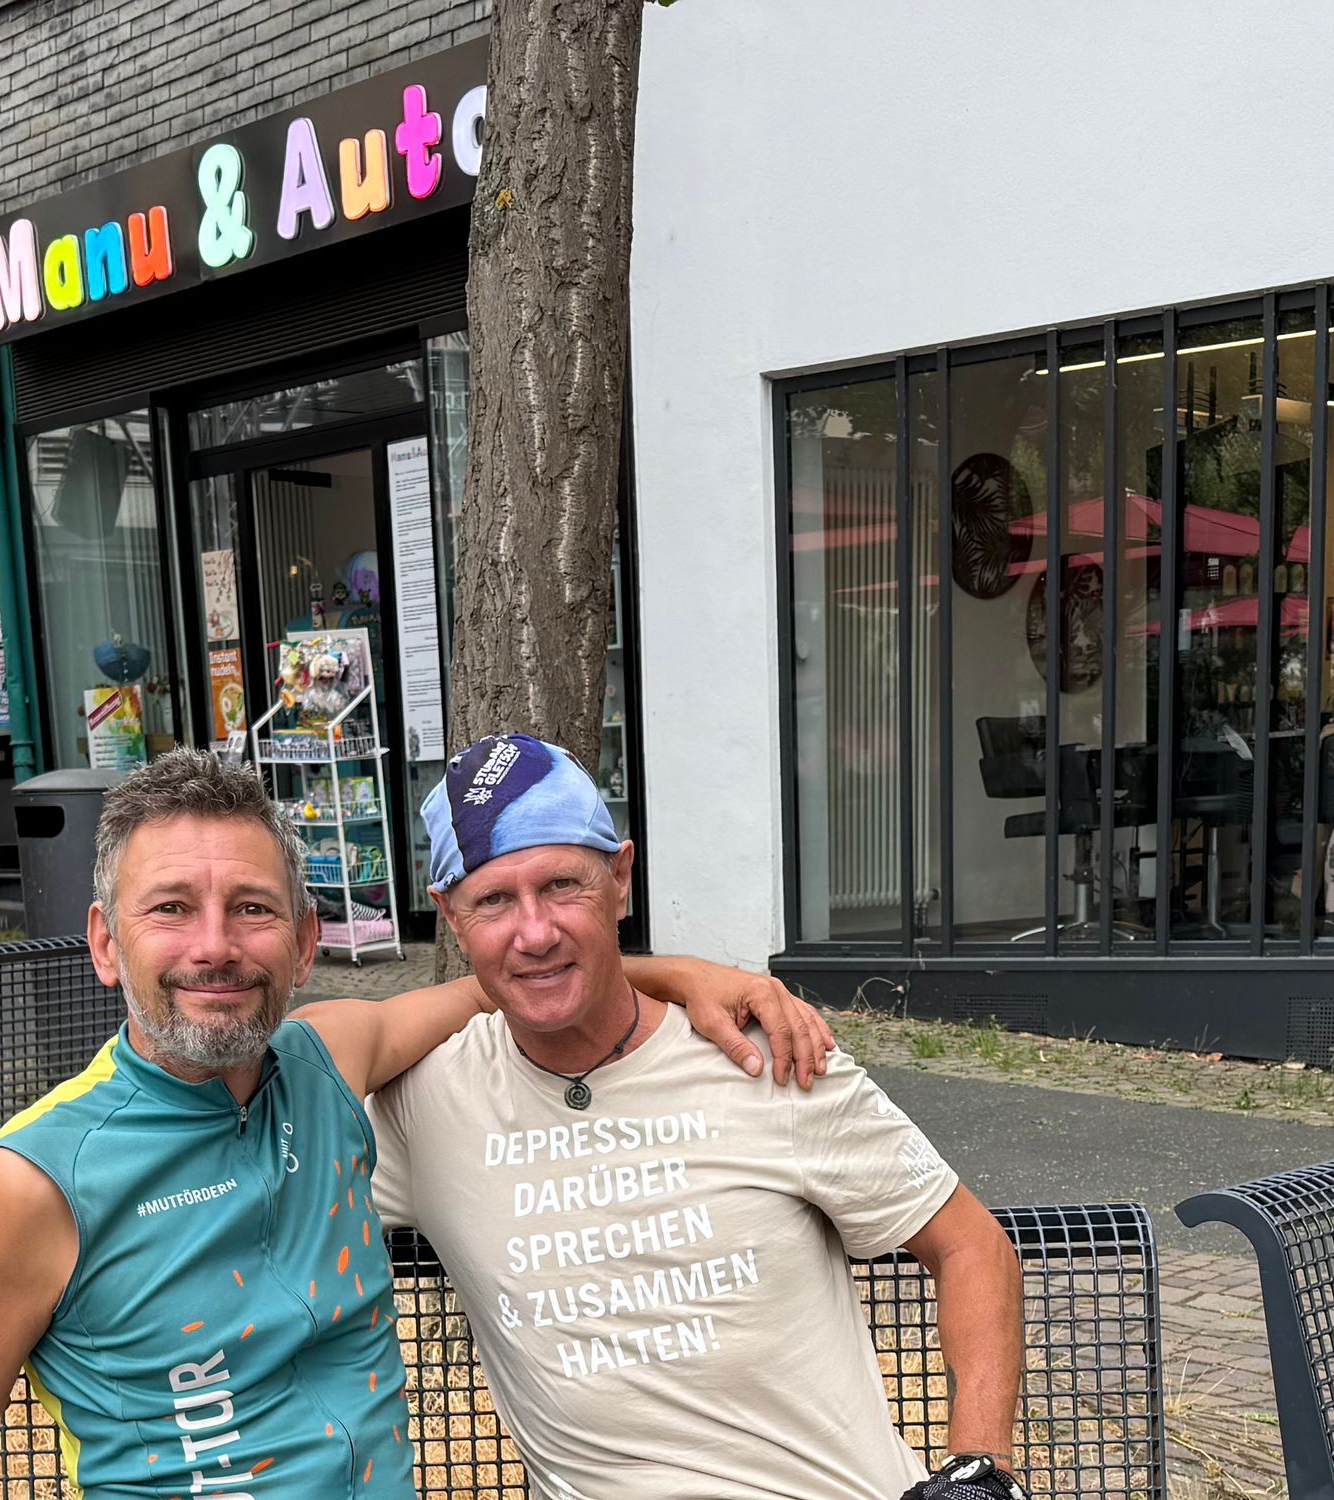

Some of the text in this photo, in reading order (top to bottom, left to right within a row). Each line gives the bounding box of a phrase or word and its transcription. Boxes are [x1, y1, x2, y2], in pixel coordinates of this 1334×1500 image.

[197, 143, 255, 268] &
[484, 1109, 720, 1168] DEPRESSION.
[136, 1178, 238, 1218] #MUTFÖRDERN
[514, 1157, 690, 1217] DARÜBER
[506, 1203, 714, 1275] SPRECHEN
[497, 1249, 759, 1329] & ZUSAMMEN
[556, 1315, 720, 1378] HALTEN!
